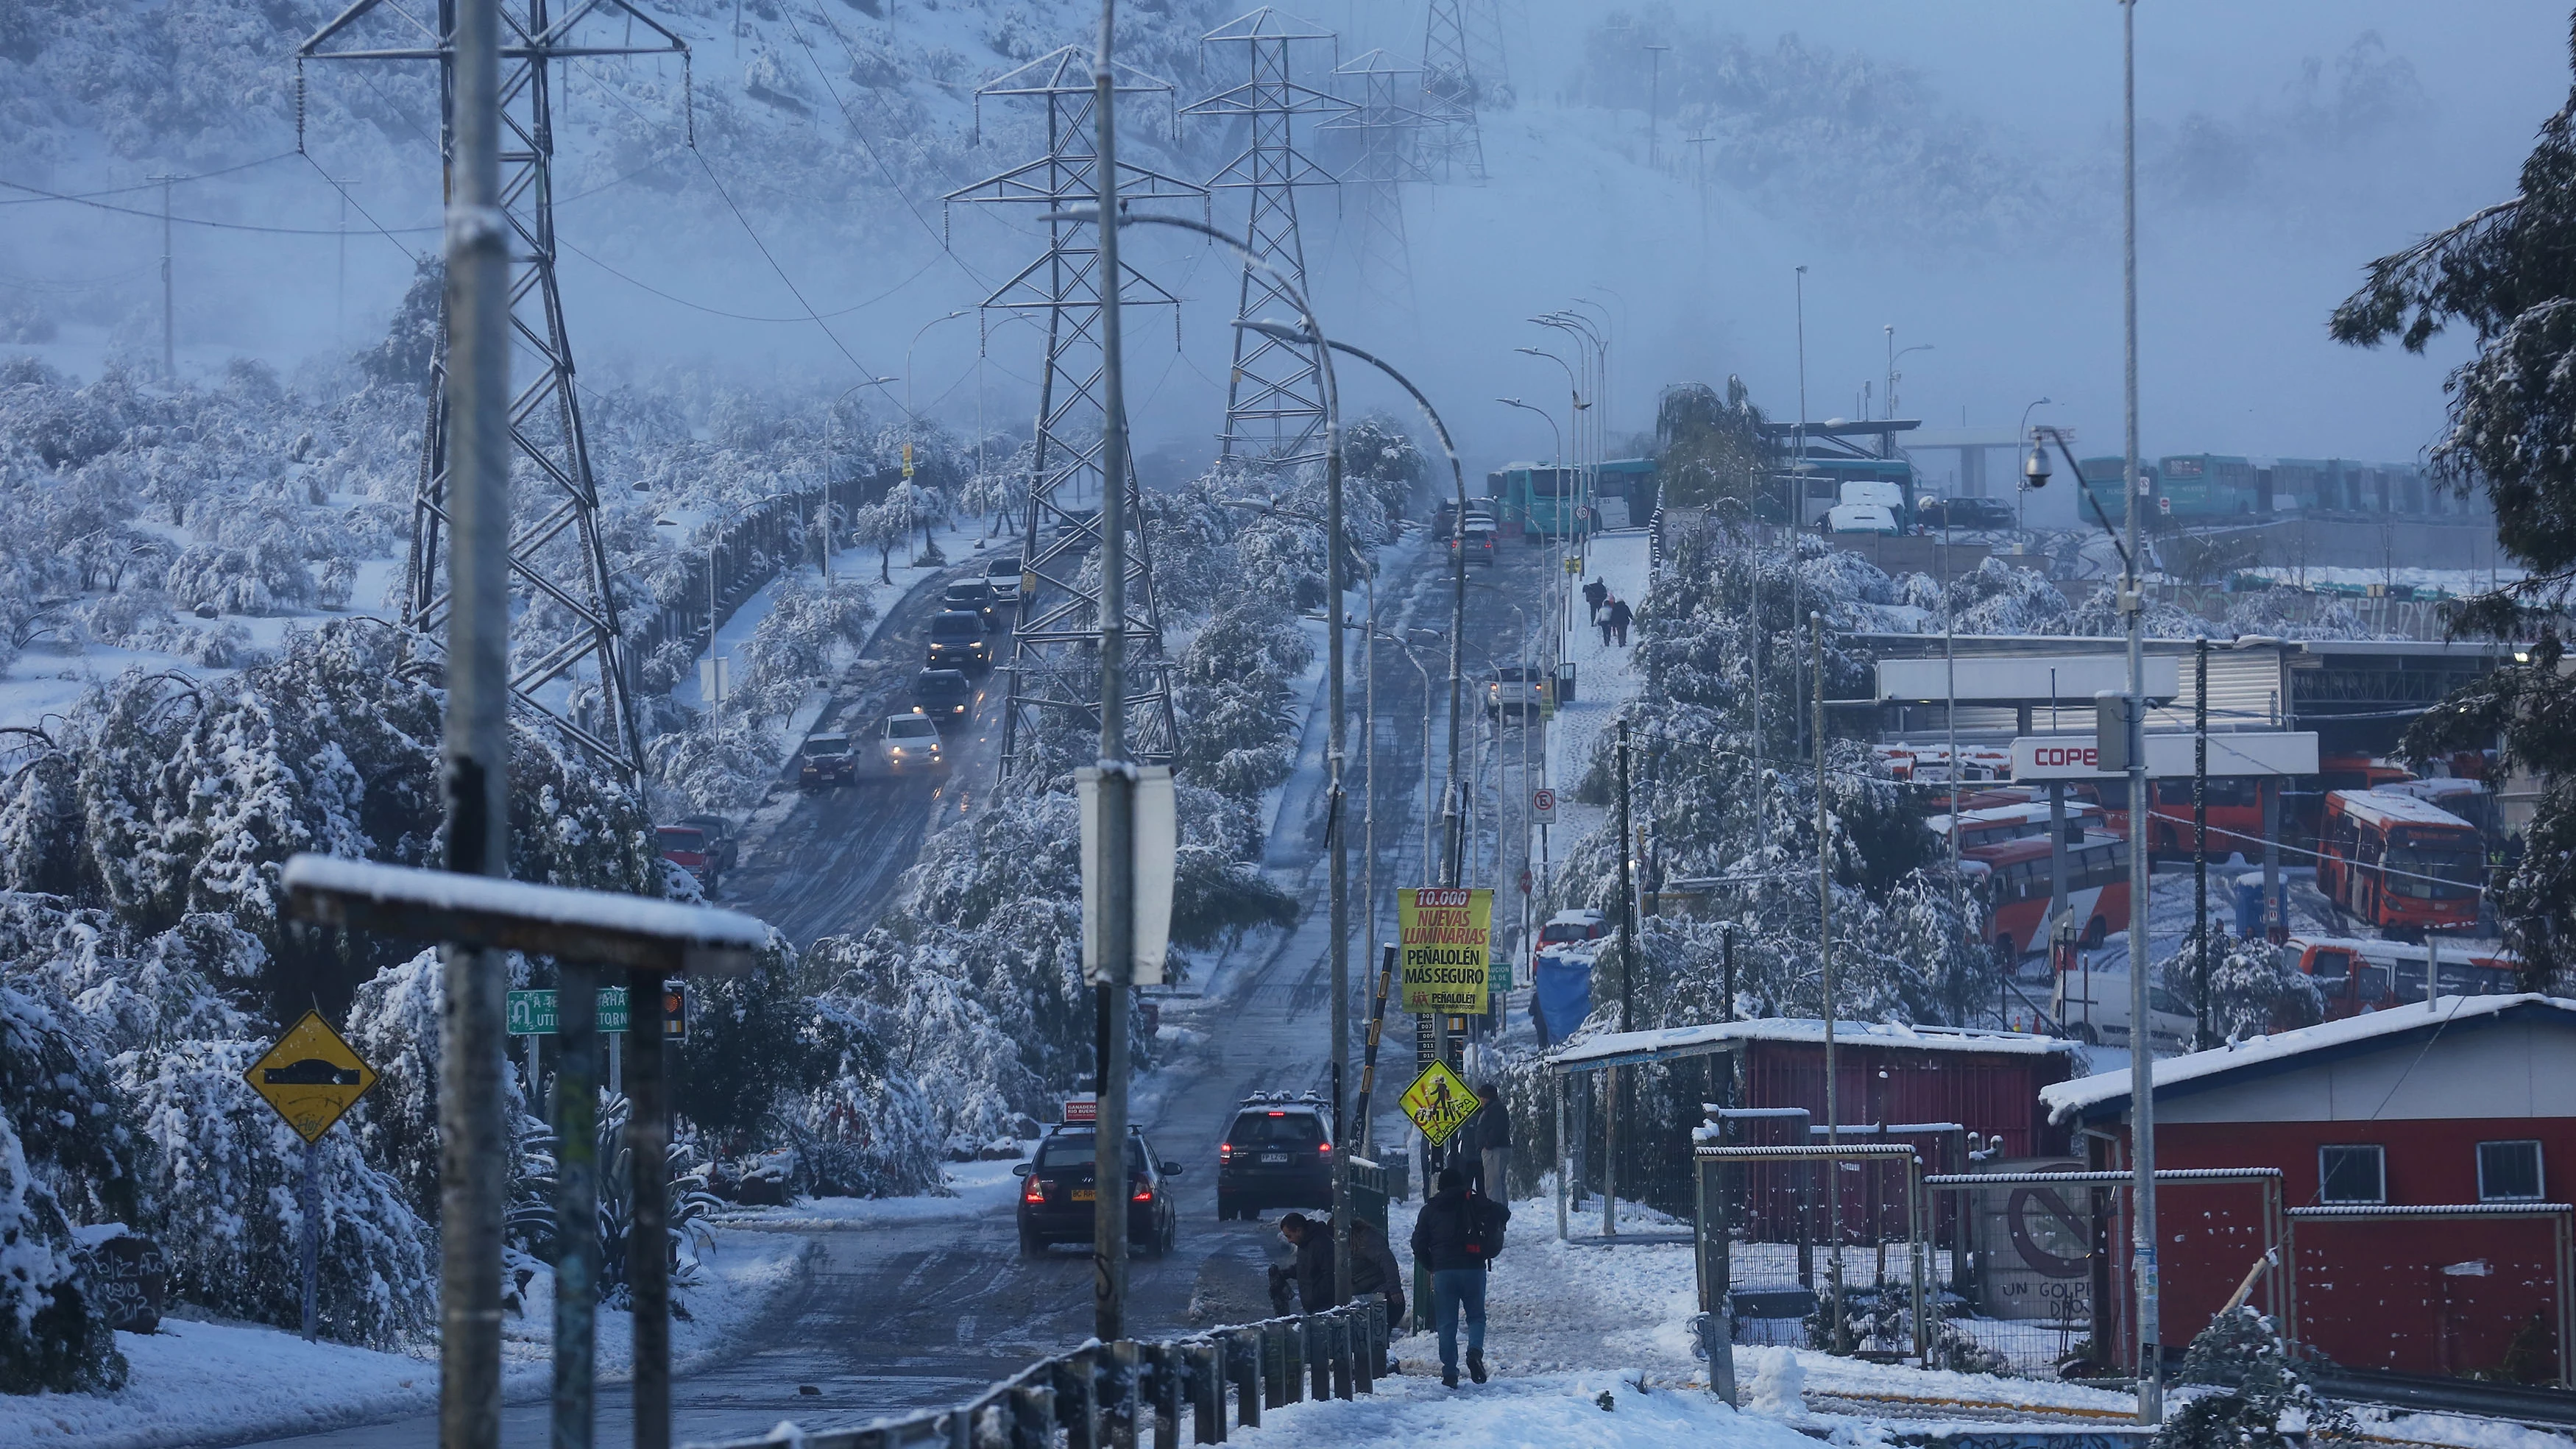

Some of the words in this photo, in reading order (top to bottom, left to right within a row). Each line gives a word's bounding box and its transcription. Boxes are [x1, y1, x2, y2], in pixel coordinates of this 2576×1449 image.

[2034, 748, 2098, 766] COPE
[1418, 891, 1467, 906] 10.000
[1417, 910, 1471, 927] NUEVAS
[1403, 927, 1487, 945] LUMINARIAS
[1407, 946, 1479, 965] PEÑALOLÉN
[1404, 966, 1433, 984] MÁS
[1434, 968, 1485, 984] SEGURO
[537, 1014, 559, 1027] UTIL
[2003, 1281, 2028, 1297] UN
